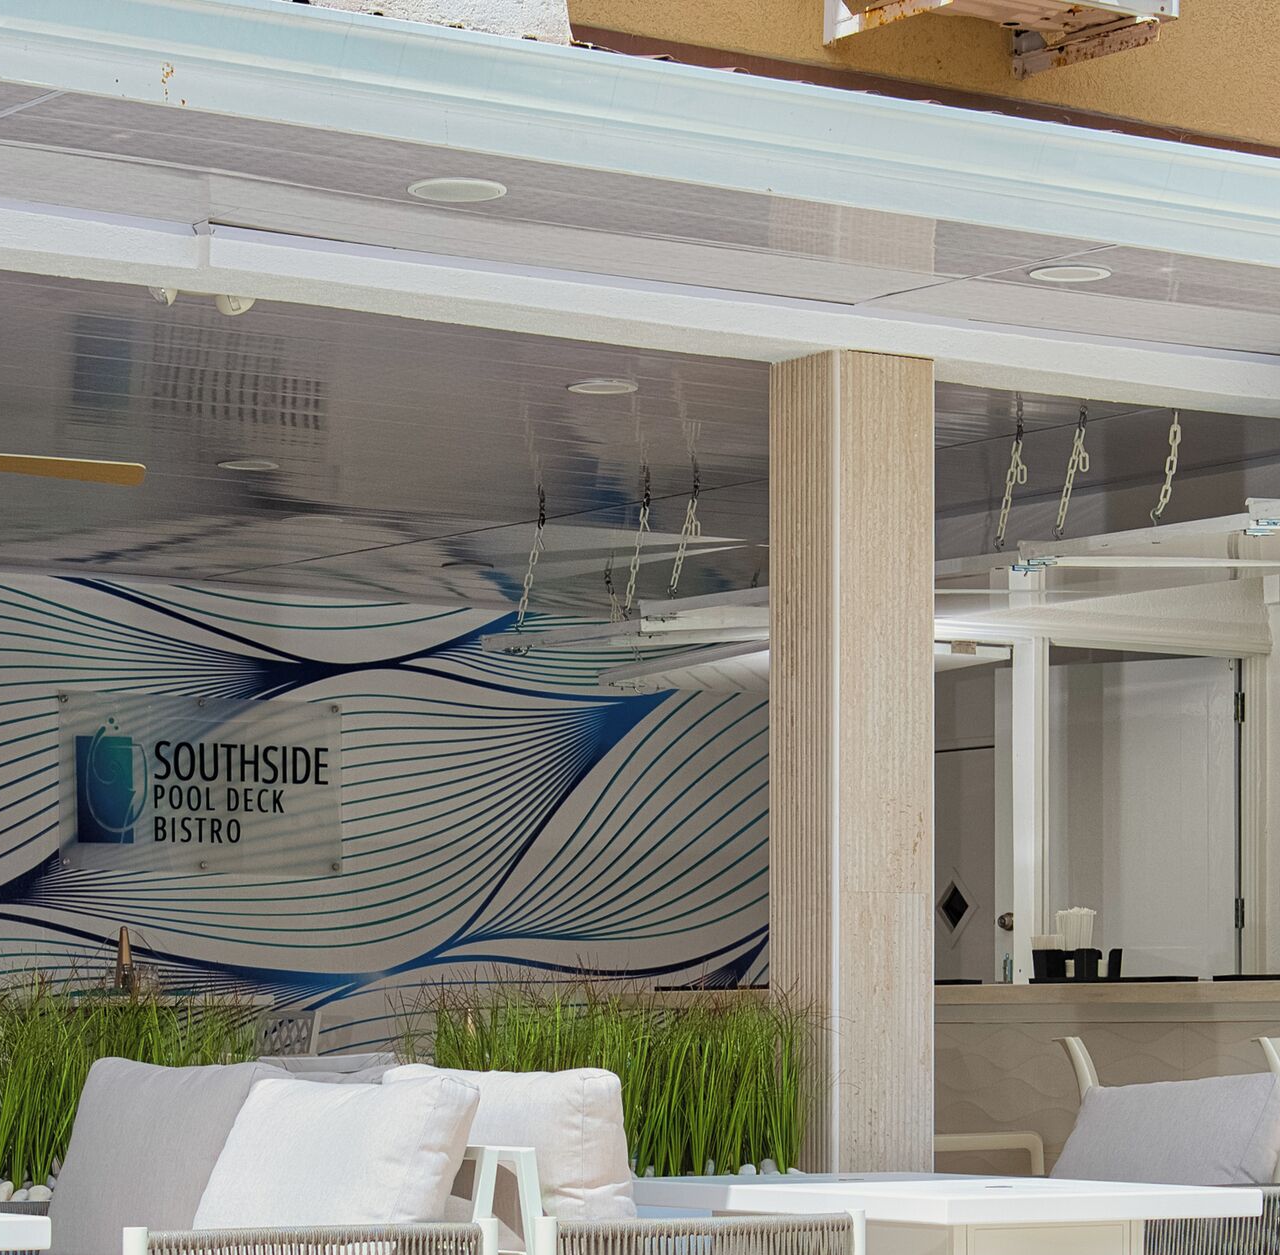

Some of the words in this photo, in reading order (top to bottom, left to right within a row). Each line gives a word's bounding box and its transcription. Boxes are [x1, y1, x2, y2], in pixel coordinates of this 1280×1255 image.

[153, 740, 329, 785] SOUTHSIDE
[154, 784, 215, 811] POOL
[227, 788, 284, 813] DECK
[154, 816, 241, 844] BISTRO
